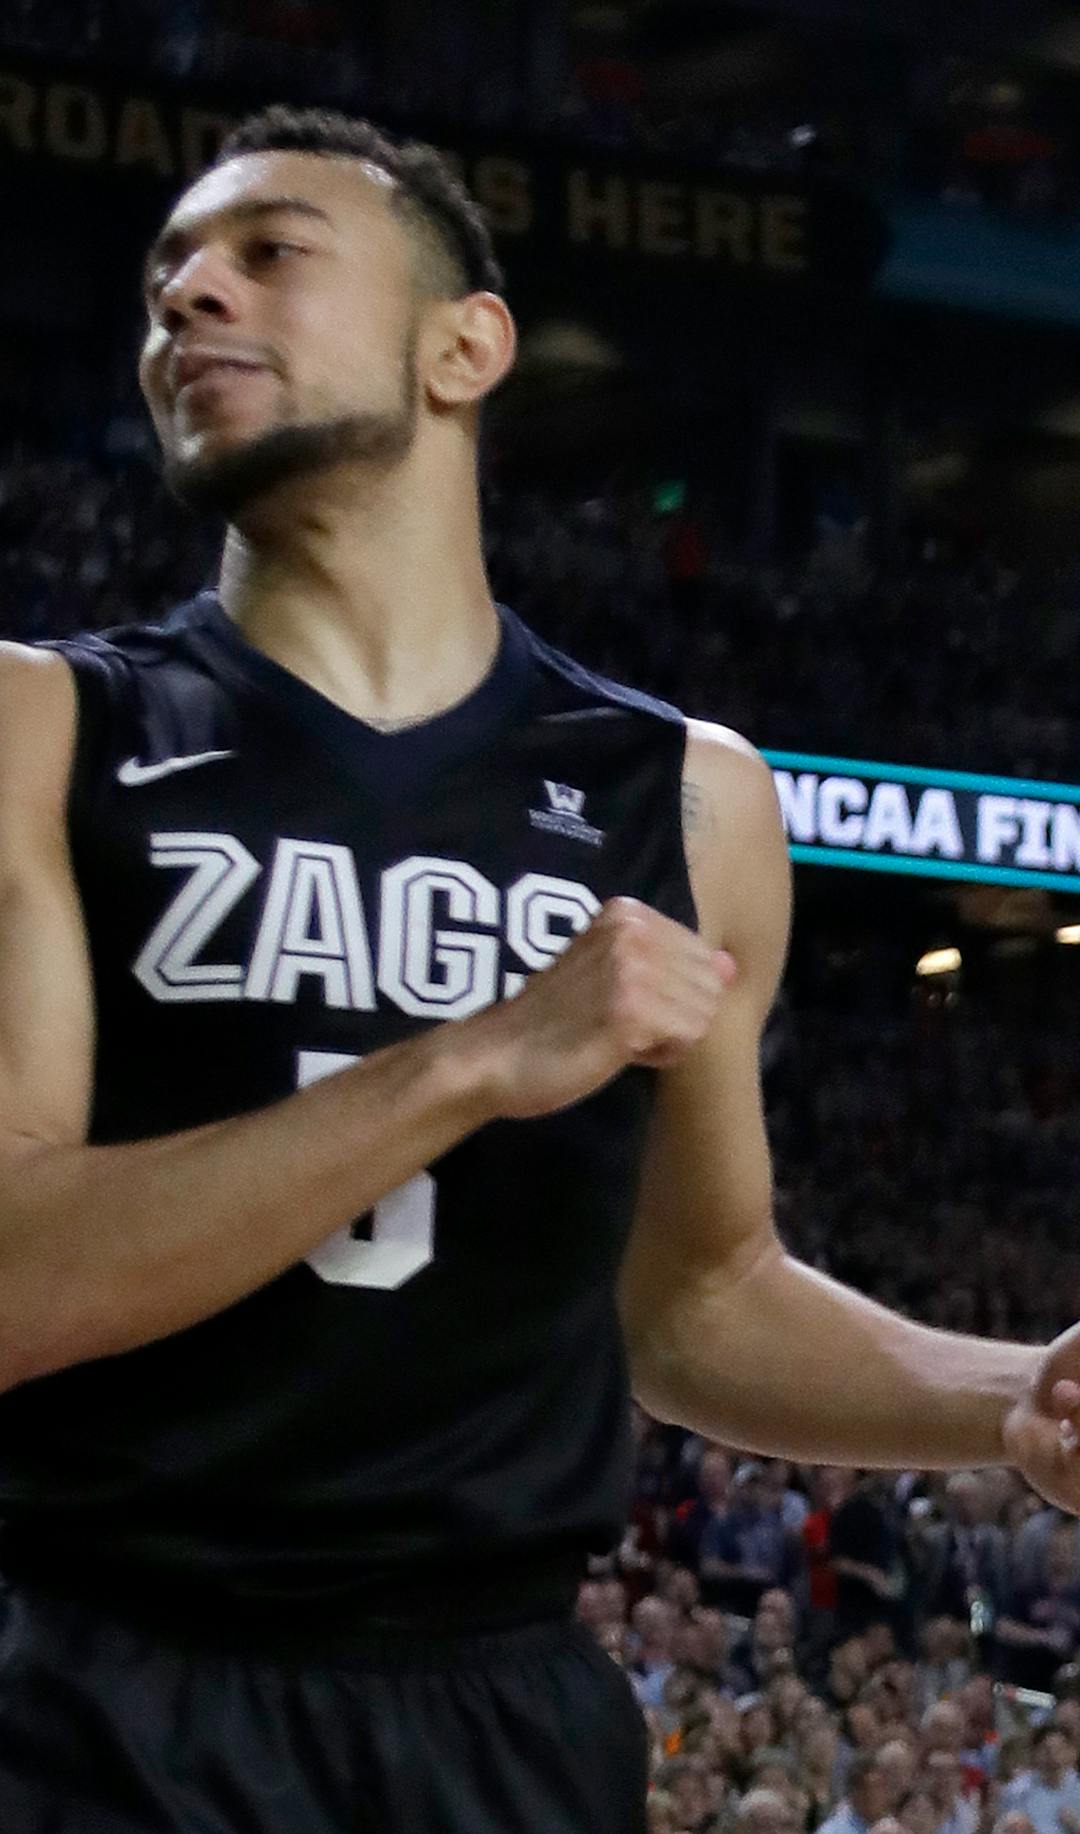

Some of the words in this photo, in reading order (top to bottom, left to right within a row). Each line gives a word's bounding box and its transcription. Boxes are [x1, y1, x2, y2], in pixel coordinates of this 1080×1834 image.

[567, 169, 810, 271] HERE
[771, 769, 965, 859] NCAA
[132, 831, 604, 1022] ZAGS
